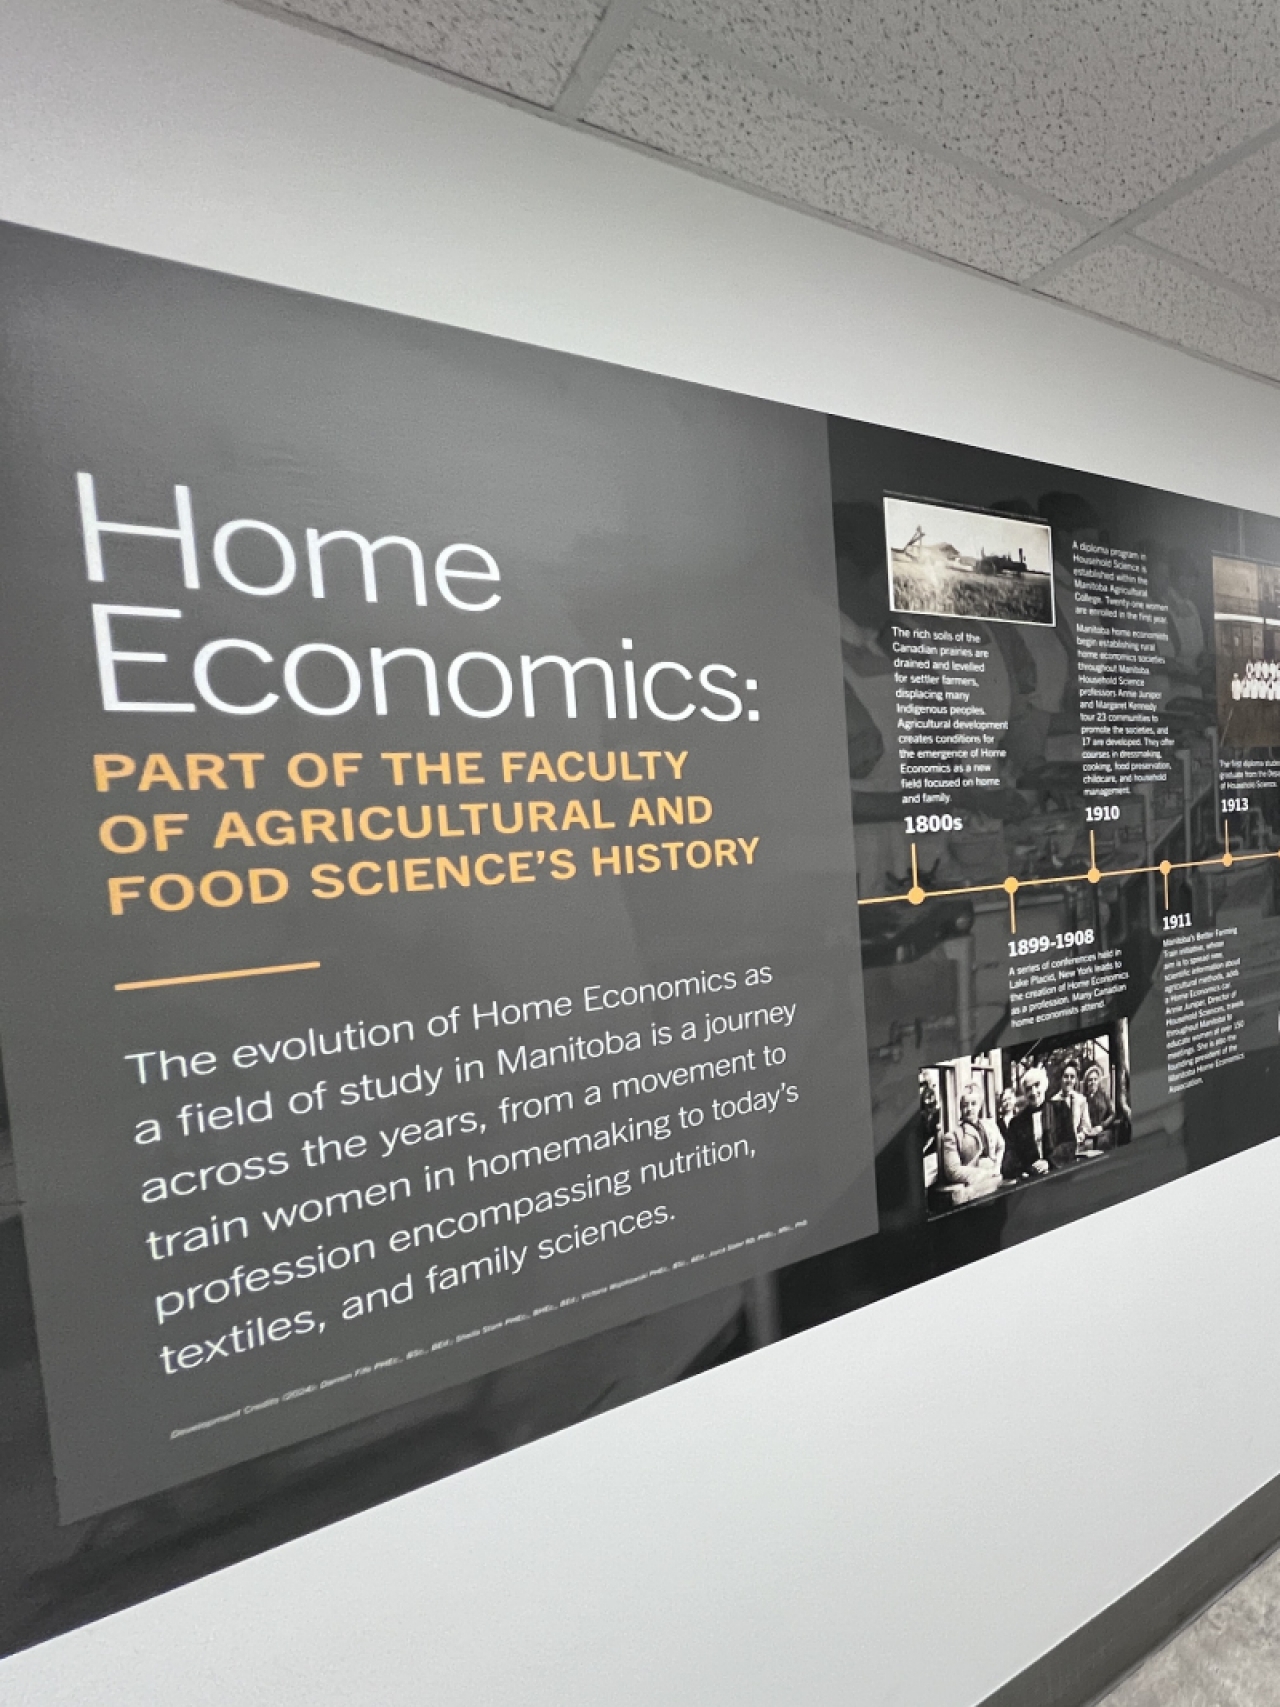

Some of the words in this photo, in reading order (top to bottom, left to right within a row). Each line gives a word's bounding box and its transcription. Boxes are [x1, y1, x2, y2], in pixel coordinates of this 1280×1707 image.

[76, 472, 501, 611] Home
[891, 626, 910, 638] The
[913, 629, 931, 638] rich
[933, 631, 952, 641] soils
[955, 632, 963, 641] of
[966, 633, 981, 643] the
[892, 643, 938, 654] Canadian
[940, 646, 972, 657] prairies
[974, 650, 988, 658] are
[92, 603, 761, 721] Economics:
[894, 658, 929, 668] drained
[932, 661, 949, 670] and
[952, 662, 984, 672] levelled
[894, 673, 907, 683] for
[910, 674, 939, 684] settler
[942, 676, 979, 686] farmers,
[896, 689, 943, 701] displacing
[945, 691, 969, 702] many
[896, 704, 947, 714] Indigenous
[897, 719, 950, 730] Agricultural
[953, 720, 1008, 730] development
[898, 734, 933, 744] creates
[936, 734, 980, 744] conditions
[984, 734, 994, 742] for
[899, 750, 914, 758] the
[917, 750, 968, 759] emergence
[970, 748, 978, 758] of
[981, 749, 1006, 757] Home
[92, 753, 264, 793] PART
[287, 752, 363, 788] OF
[383, 752, 484, 786] THE
[502, 749, 689, 783] FACULTY
[900, 764, 950, 774] Economics
[901, 778, 921, 788] field
[925, 778, 960, 787] focused
[976, 777, 1000, 786] home
[902, 794, 920, 804] and
[1221, 798, 1248, 812] 1913
[1086, 806, 1120, 821] 1910
[99, 812, 190, 853] OF
[214, 800, 615, 849] AGRICULTURAL
[628, 795, 712, 829] AND
[904, 814, 963, 834] 1800s
[108, 869, 289, 916] FOOD
[311, 849, 576, 900] SCIENCE'S
[593, 837, 759, 877] HISTORY
[1163, 913, 1192, 930] 1911
[1008, 929, 1094, 957] 1899-1908
[126, 1048, 217, 1087] The
[232, 1019, 413, 1071] evolution
[428, 1005, 462, 1038] of
[472, 991, 573, 1030] Home
[583, 970, 736, 1014] Economics
[745, 962, 773, 986] as
[134, 1116, 163, 1146] a
[176, 1092, 274, 1135] field
[289, 1084, 327, 1115] of
[339, 1065, 442, 1108] study
[456, 1056, 484, 1084] in
[496, 1028, 642, 1075] Manitoba
[652, 1021, 672, 1046] is
[681, 1021, 697, 1042] a
[704, 1001, 798, 1041] journey
[141, 1152, 288, 1204] across
[302, 1134, 367, 1166] the
[380, 1108, 487, 1158] years,
[499, 1087, 573, 1126] from
[583, 1087, 601, 1105] a
[612, 1048, 754, 1096] movement
[763, 1043, 786, 1065] to
[147, 1213, 249, 1263] train
[263, 1177, 411, 1228] women
[425, 1164, 454, 1192] in
[467, 1112, 671, 1183] homemaking
[679, 1103, 704, 1128] to
[712, 1084, 800, 1124] today's
[155, 1237, 374, 1323] profession
[388, 1167, 630, 1256] encompassing
[640, 1132, 757, 1186] nutrition,
[160, 1312, 326, 1377] textiles,
[341, 1276, 413, 1321] and
[427, 1244, 526, 1296] family
[538, 1202, 674, 1261] sciences.
